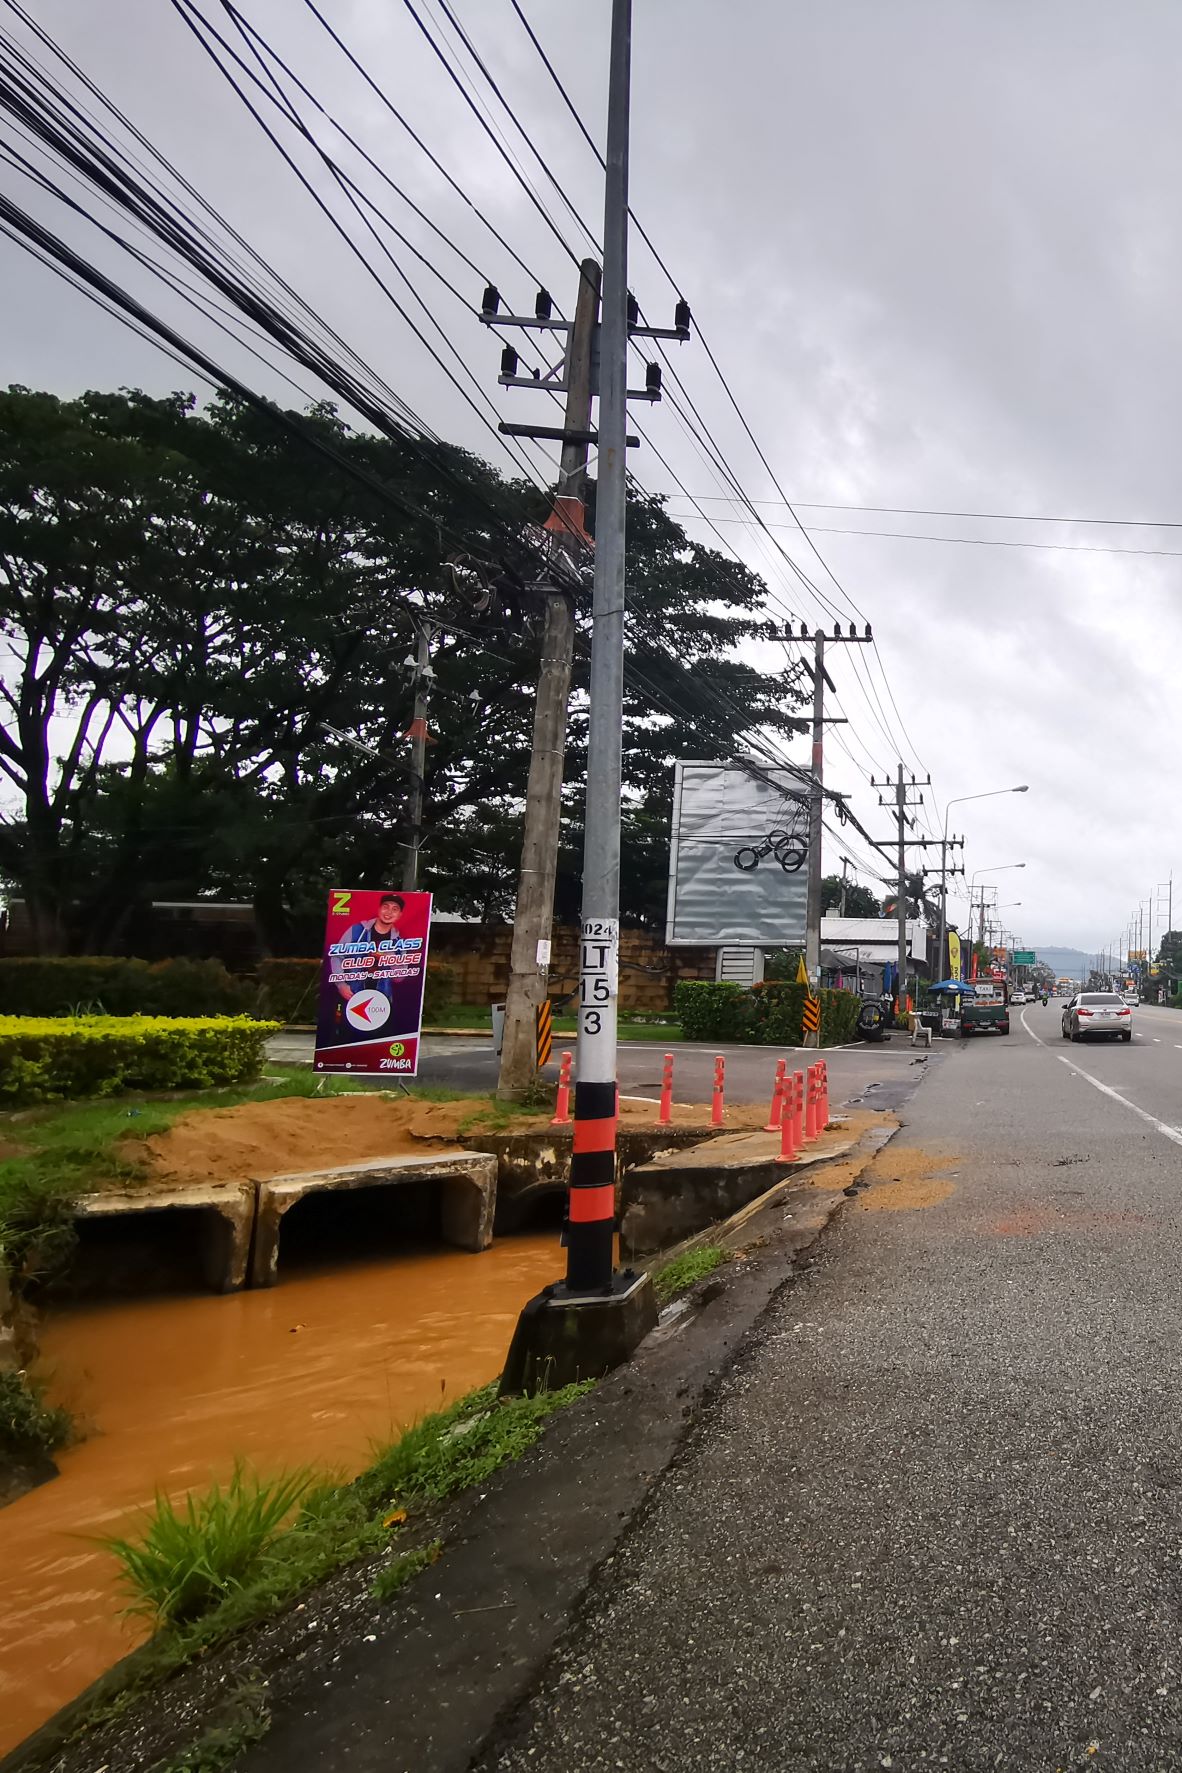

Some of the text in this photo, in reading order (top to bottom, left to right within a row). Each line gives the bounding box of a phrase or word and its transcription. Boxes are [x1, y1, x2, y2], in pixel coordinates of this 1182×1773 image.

[328, 938, 422, 956] ZUMBA CLASS
[342, 953, 421, 970] CLUB HOUSE
[582, 945, 611, 968] LT
[328, 971, 367, 982] MONDAY
[372, 967, 420, 979] SATURDAY
[580, 978, 610, 1001] 15
[584, 1011, 601, 1035] 3
[380, 1058, 411, 1069] ZUMBA
